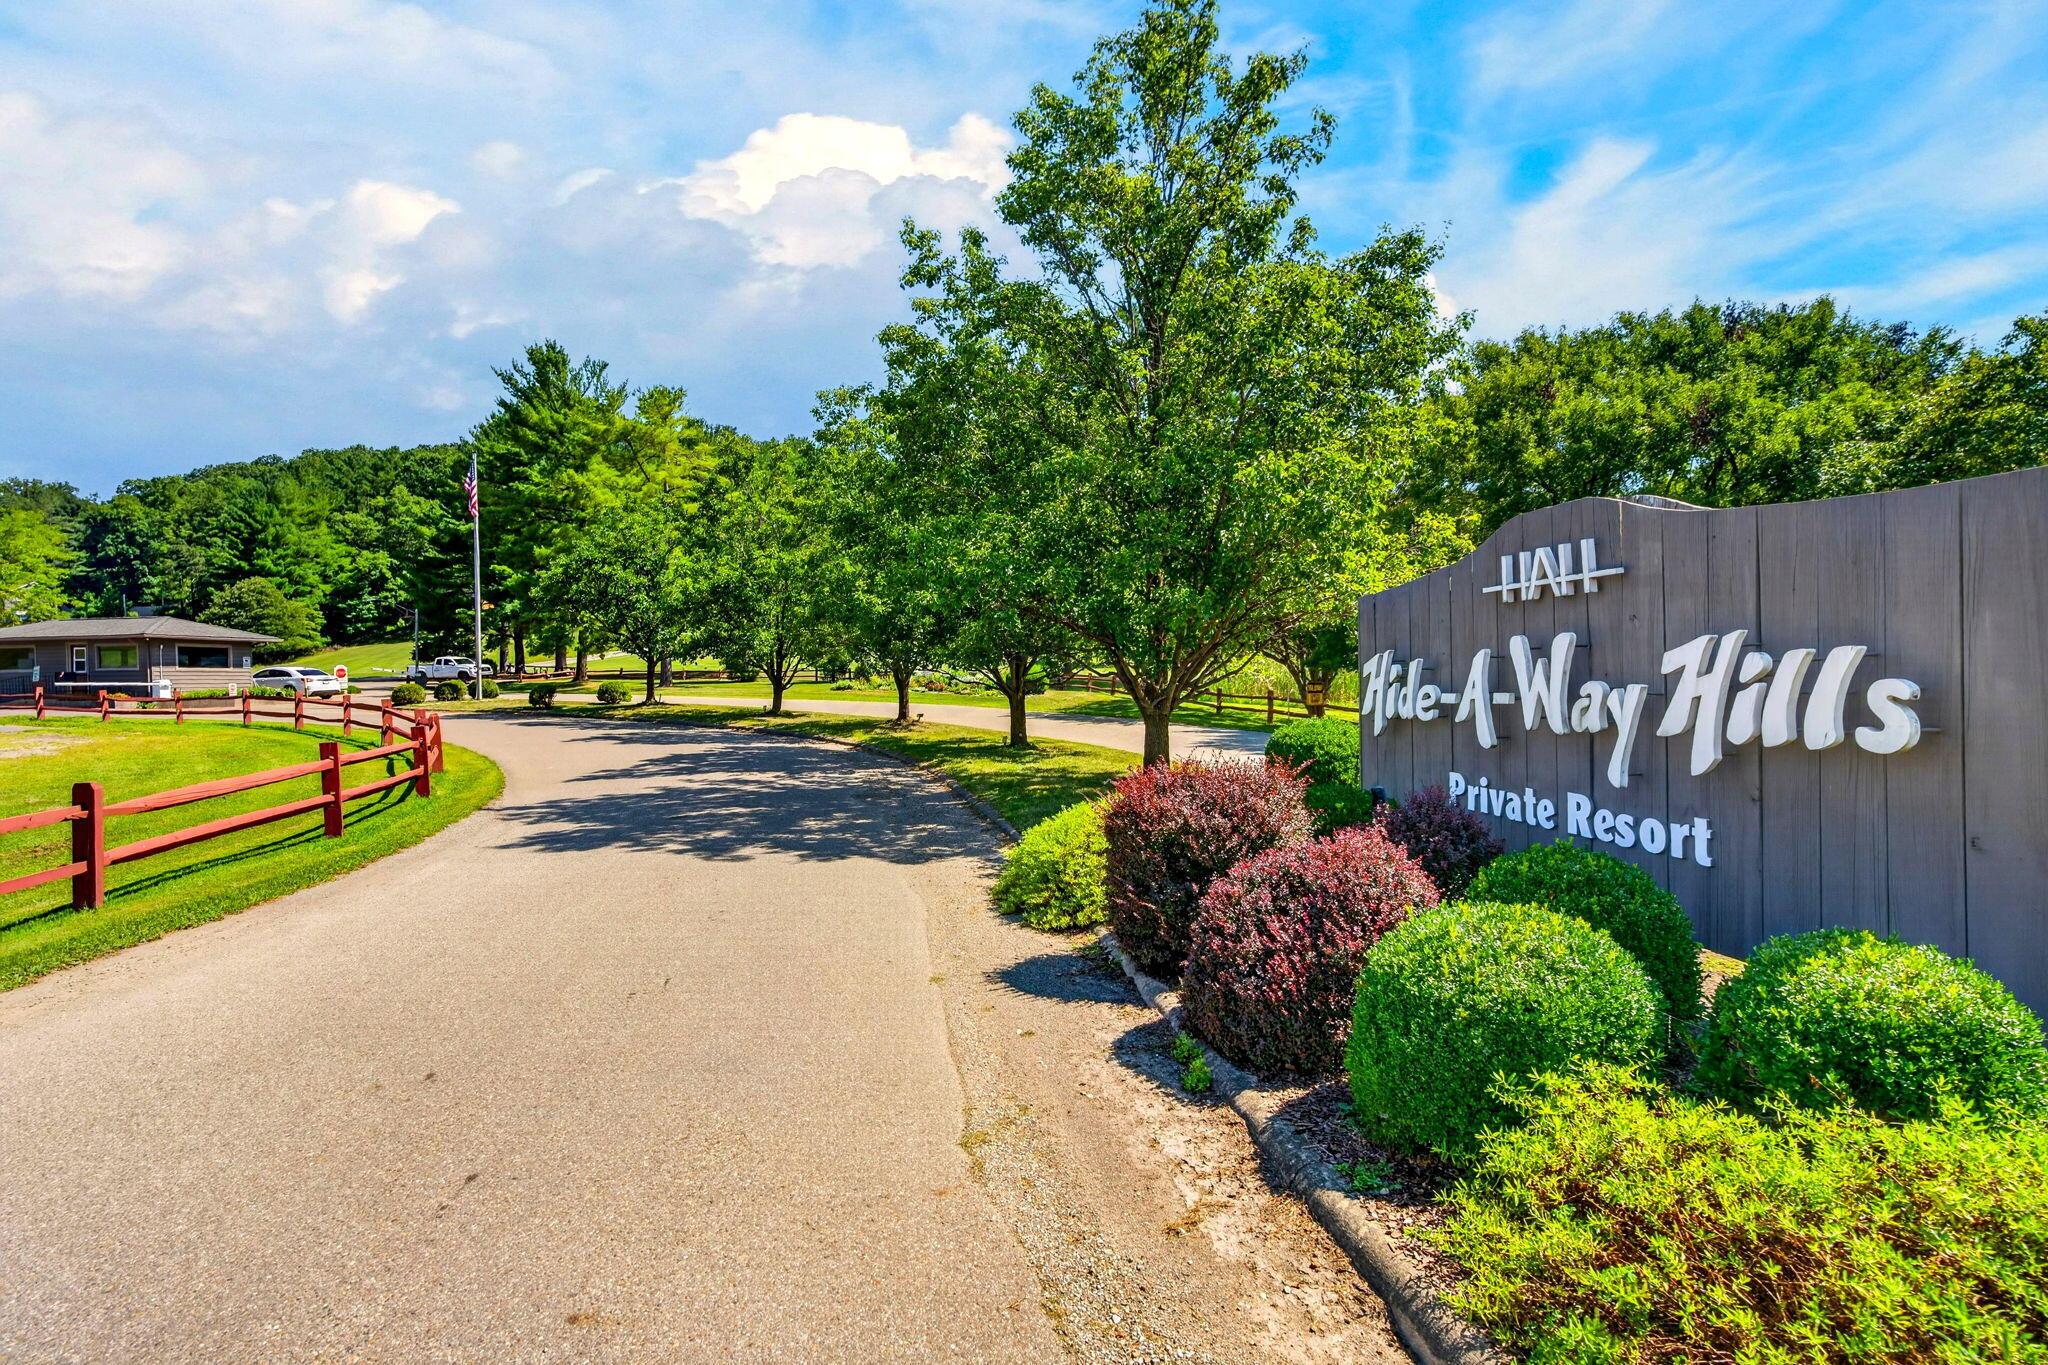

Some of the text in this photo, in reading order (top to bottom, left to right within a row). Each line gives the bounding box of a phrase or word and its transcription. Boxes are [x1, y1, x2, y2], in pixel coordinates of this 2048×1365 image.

[1361, 629, 1921, 788] Hide-A-Way Hills
[1449, 772, 1713, 867] Private Resort
